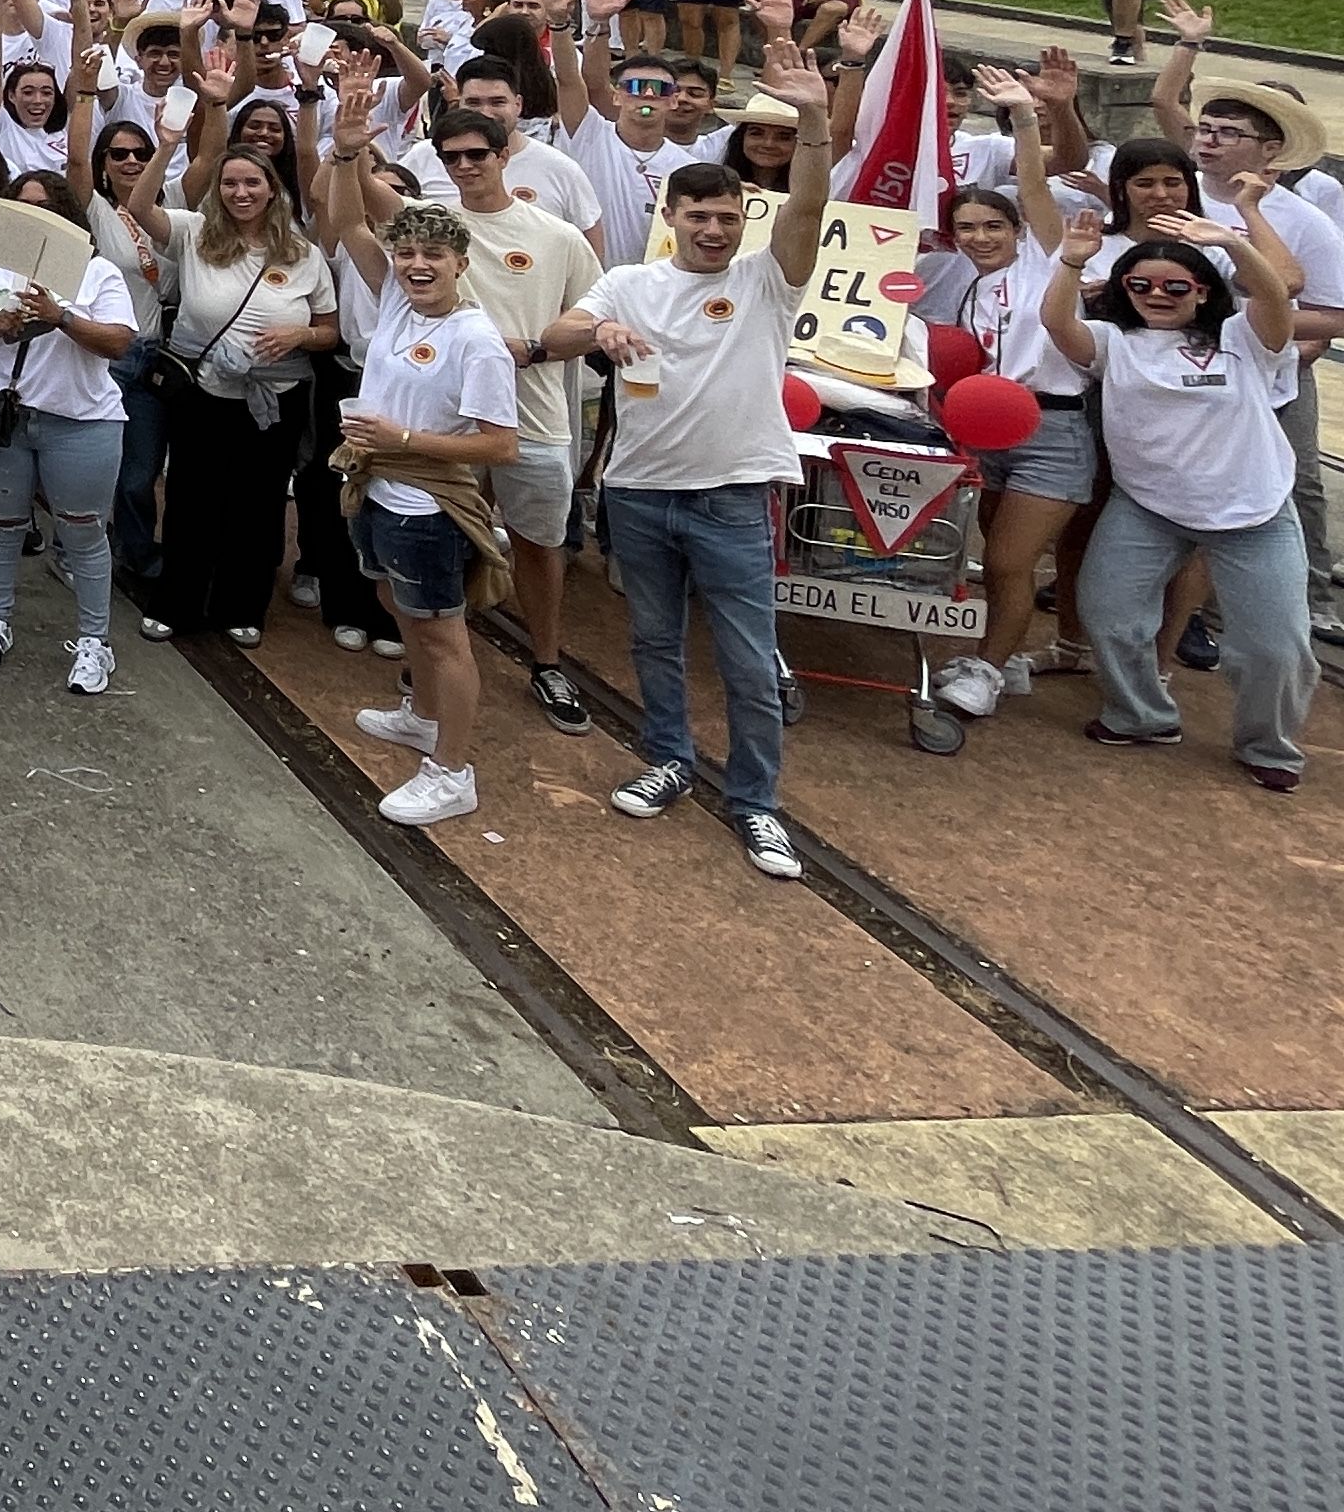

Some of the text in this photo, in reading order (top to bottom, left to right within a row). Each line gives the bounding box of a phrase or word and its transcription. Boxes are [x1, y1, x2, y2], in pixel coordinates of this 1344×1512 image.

[820, 268, 872, 307] EL
[862, 460, 921, 485] CEDA
[878, 483, 910, 498] EL
[866, 498, 910, 520] VASO
[775, 581, 977, 630] CEDA EL VASO
